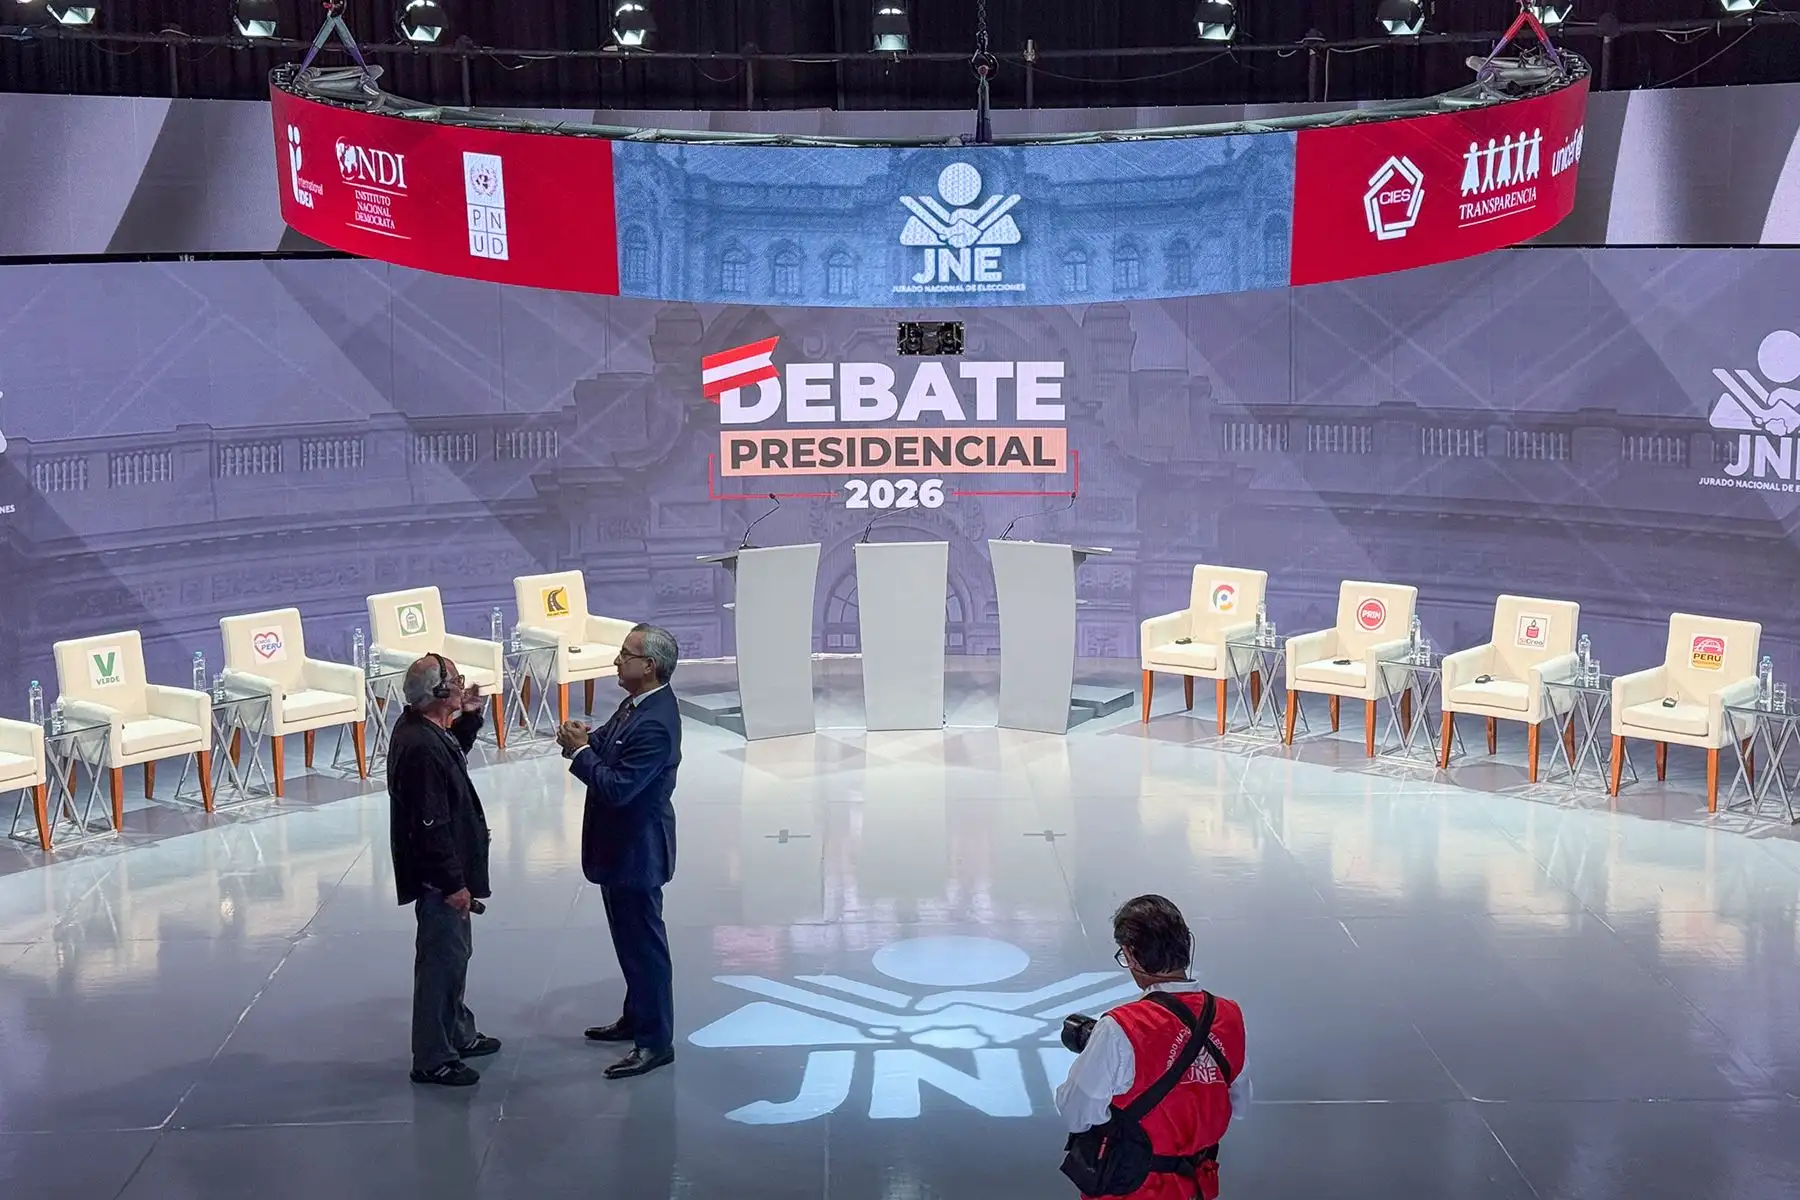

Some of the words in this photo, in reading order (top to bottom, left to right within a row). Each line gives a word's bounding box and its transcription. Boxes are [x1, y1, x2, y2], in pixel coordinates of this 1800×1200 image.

[356, 146, 408, 189] NDI
[355, 189, 392, 207] INSTITUTO
[357, 201, 392, 218] NACIONAL
[1379, 188, 1411, 206] CIES
[1458, 187, 1537, 220] TRANSPARENCIA
[911, 247, 1003, 284] JNE
[893, 285, 923, 293] JURADO
[924, 284, 964, 293] NACIONAL
[965, 284, 977, 292] DE
[978, 283, 1026, 292] ELECCIONES
[720, 361, 1066, 425] DEBATE
[730, 435, 1057, 470] PRESIDENCIAL
[1724, 434, 1800, 480] JN
[843, 478, 945, 509] 2026
[1698, 477, 1735, 487] JURADO
[1736, 479, 1780, 491] NACIONAL
[1782, 483, 1794, 492] DE
[93, 652, 115, 677] V
[1187, 1066, 1217, 1082] JNE
